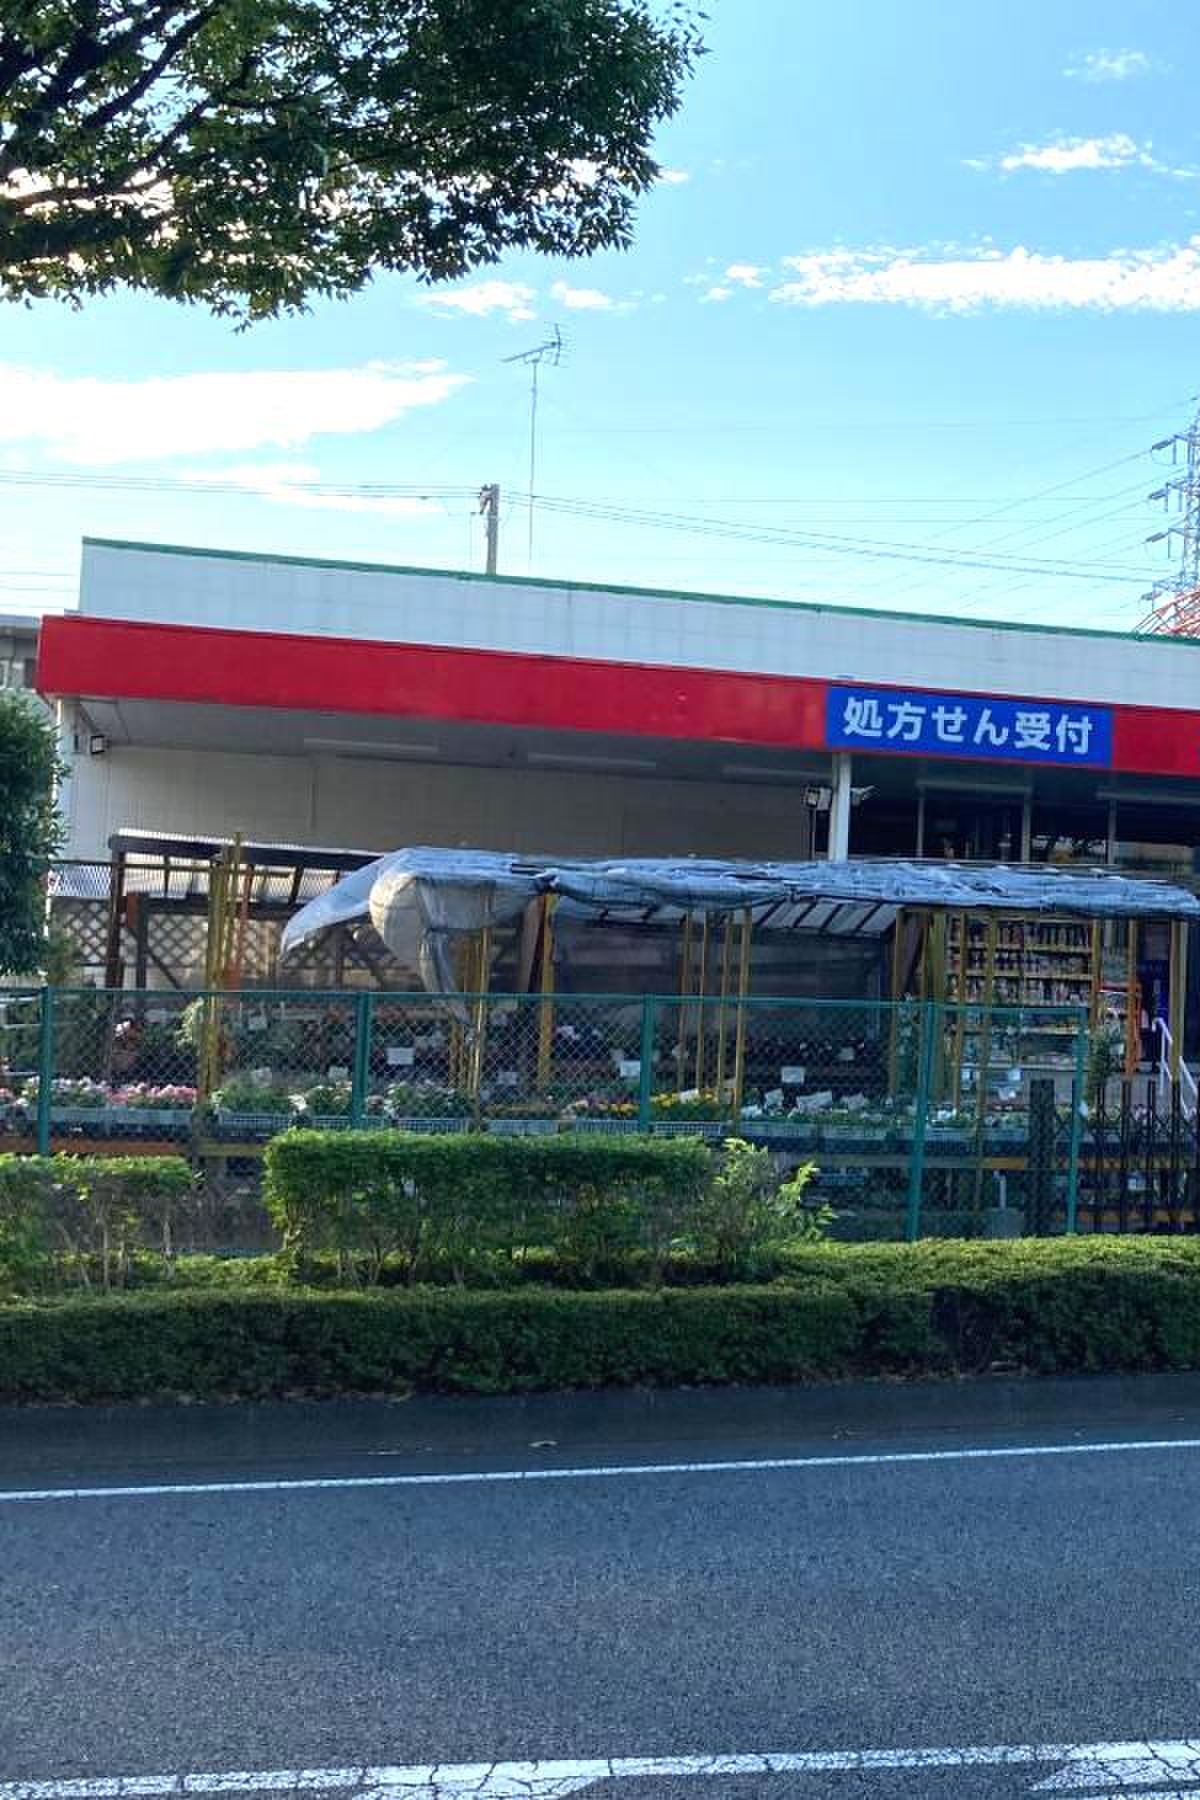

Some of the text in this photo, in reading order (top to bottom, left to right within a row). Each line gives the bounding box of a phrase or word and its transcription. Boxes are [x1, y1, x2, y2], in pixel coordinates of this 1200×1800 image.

[843, 697, 1093, 755] 処方せん受付
